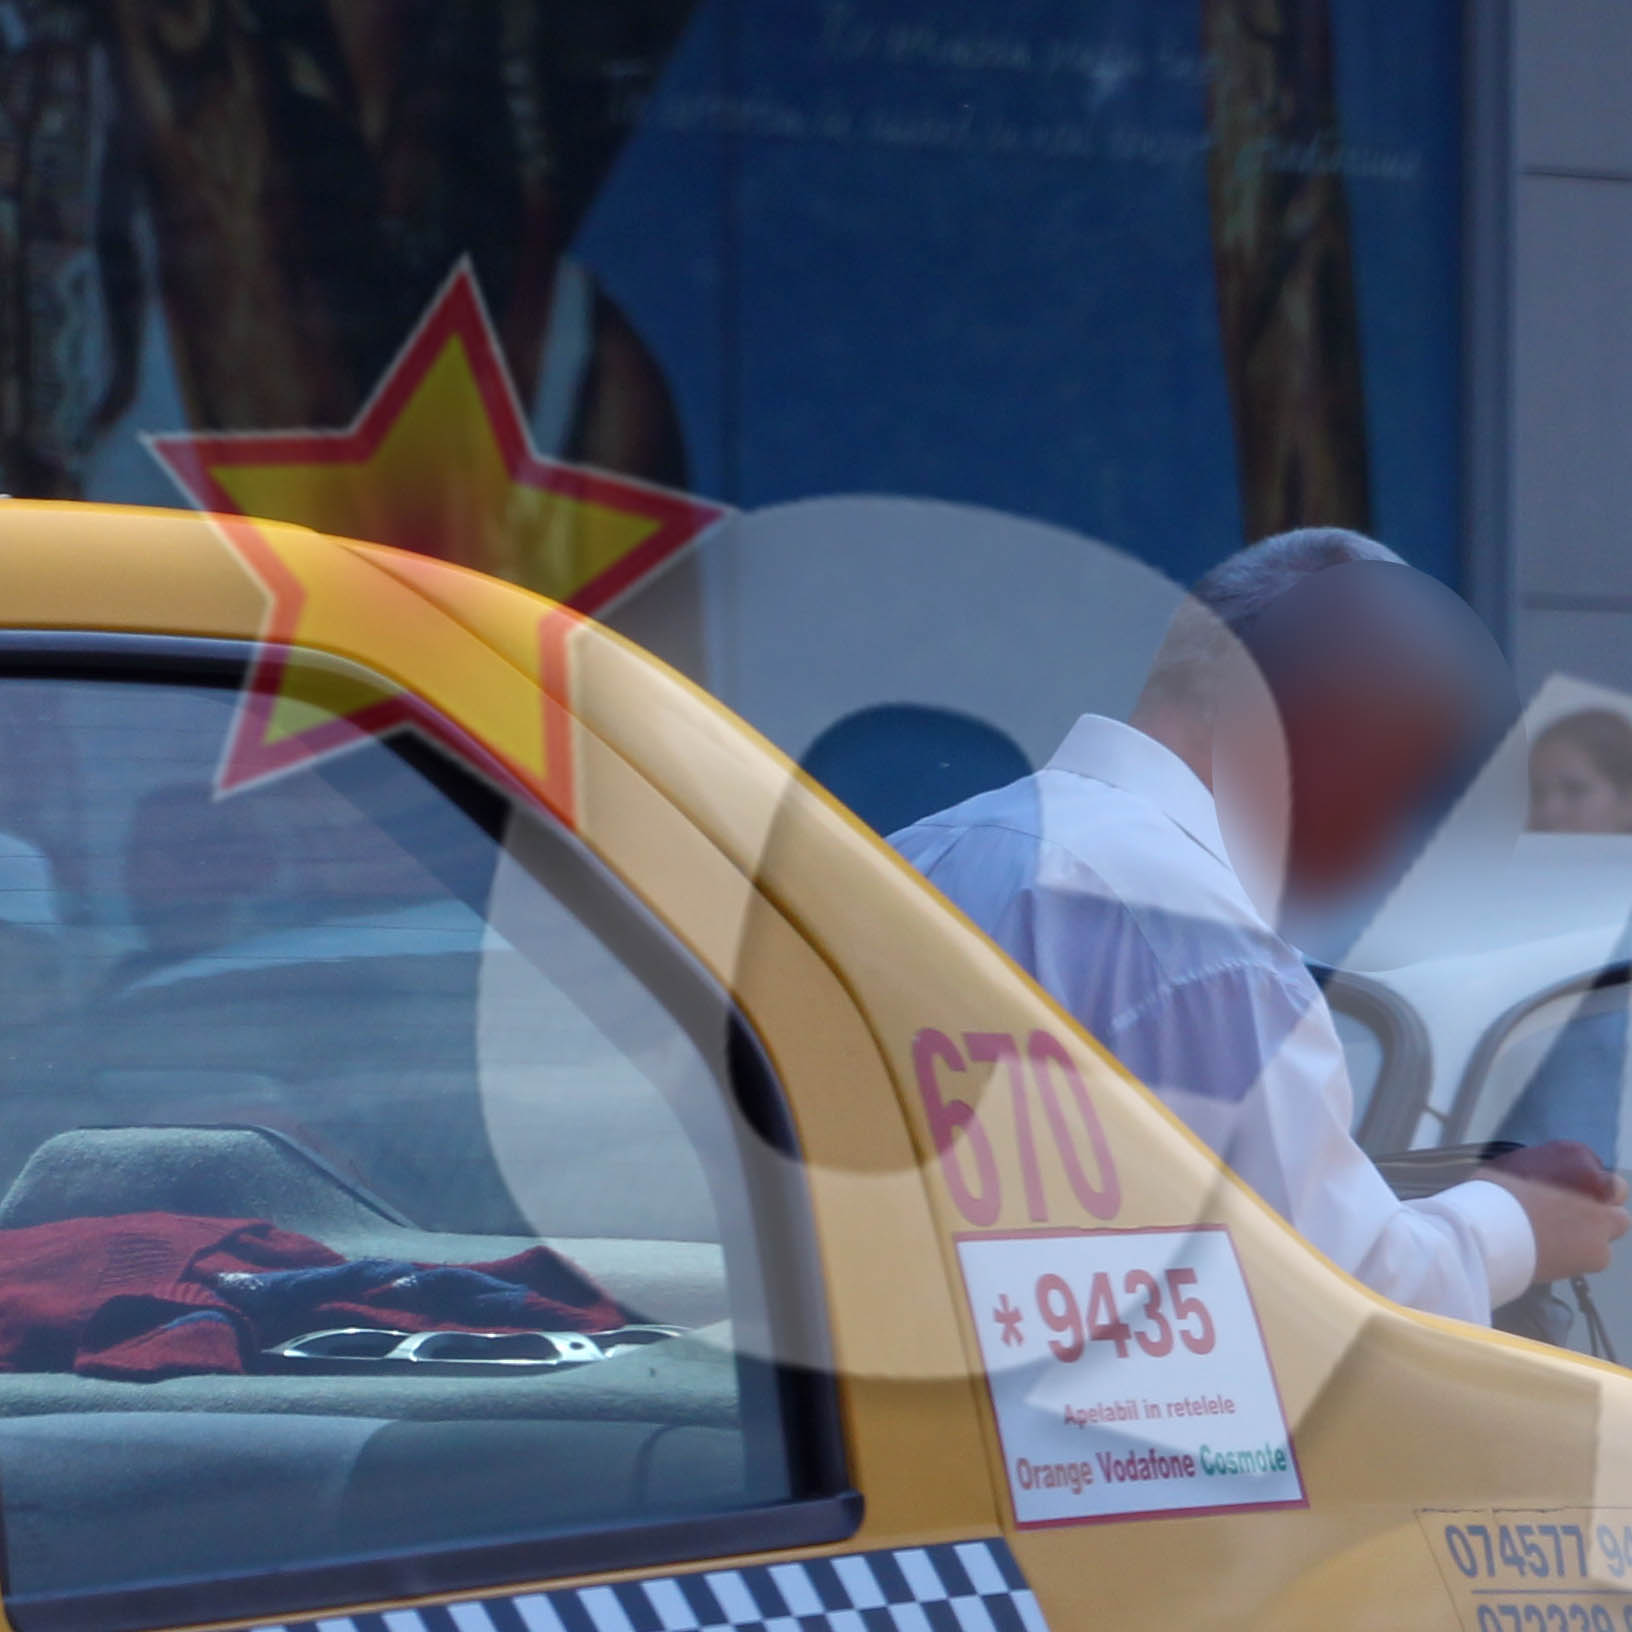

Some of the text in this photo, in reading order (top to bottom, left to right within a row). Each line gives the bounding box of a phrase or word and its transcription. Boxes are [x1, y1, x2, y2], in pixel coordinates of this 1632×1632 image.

[911, 1027, 1123, 1228] 670
[1062, 1393, 1237, 1430] Apelabil in retelele
[1014, 1441, 1289, 1496] Orange Vodafone Cosmote
[1443, 1523, 1589, 1579] 074577
